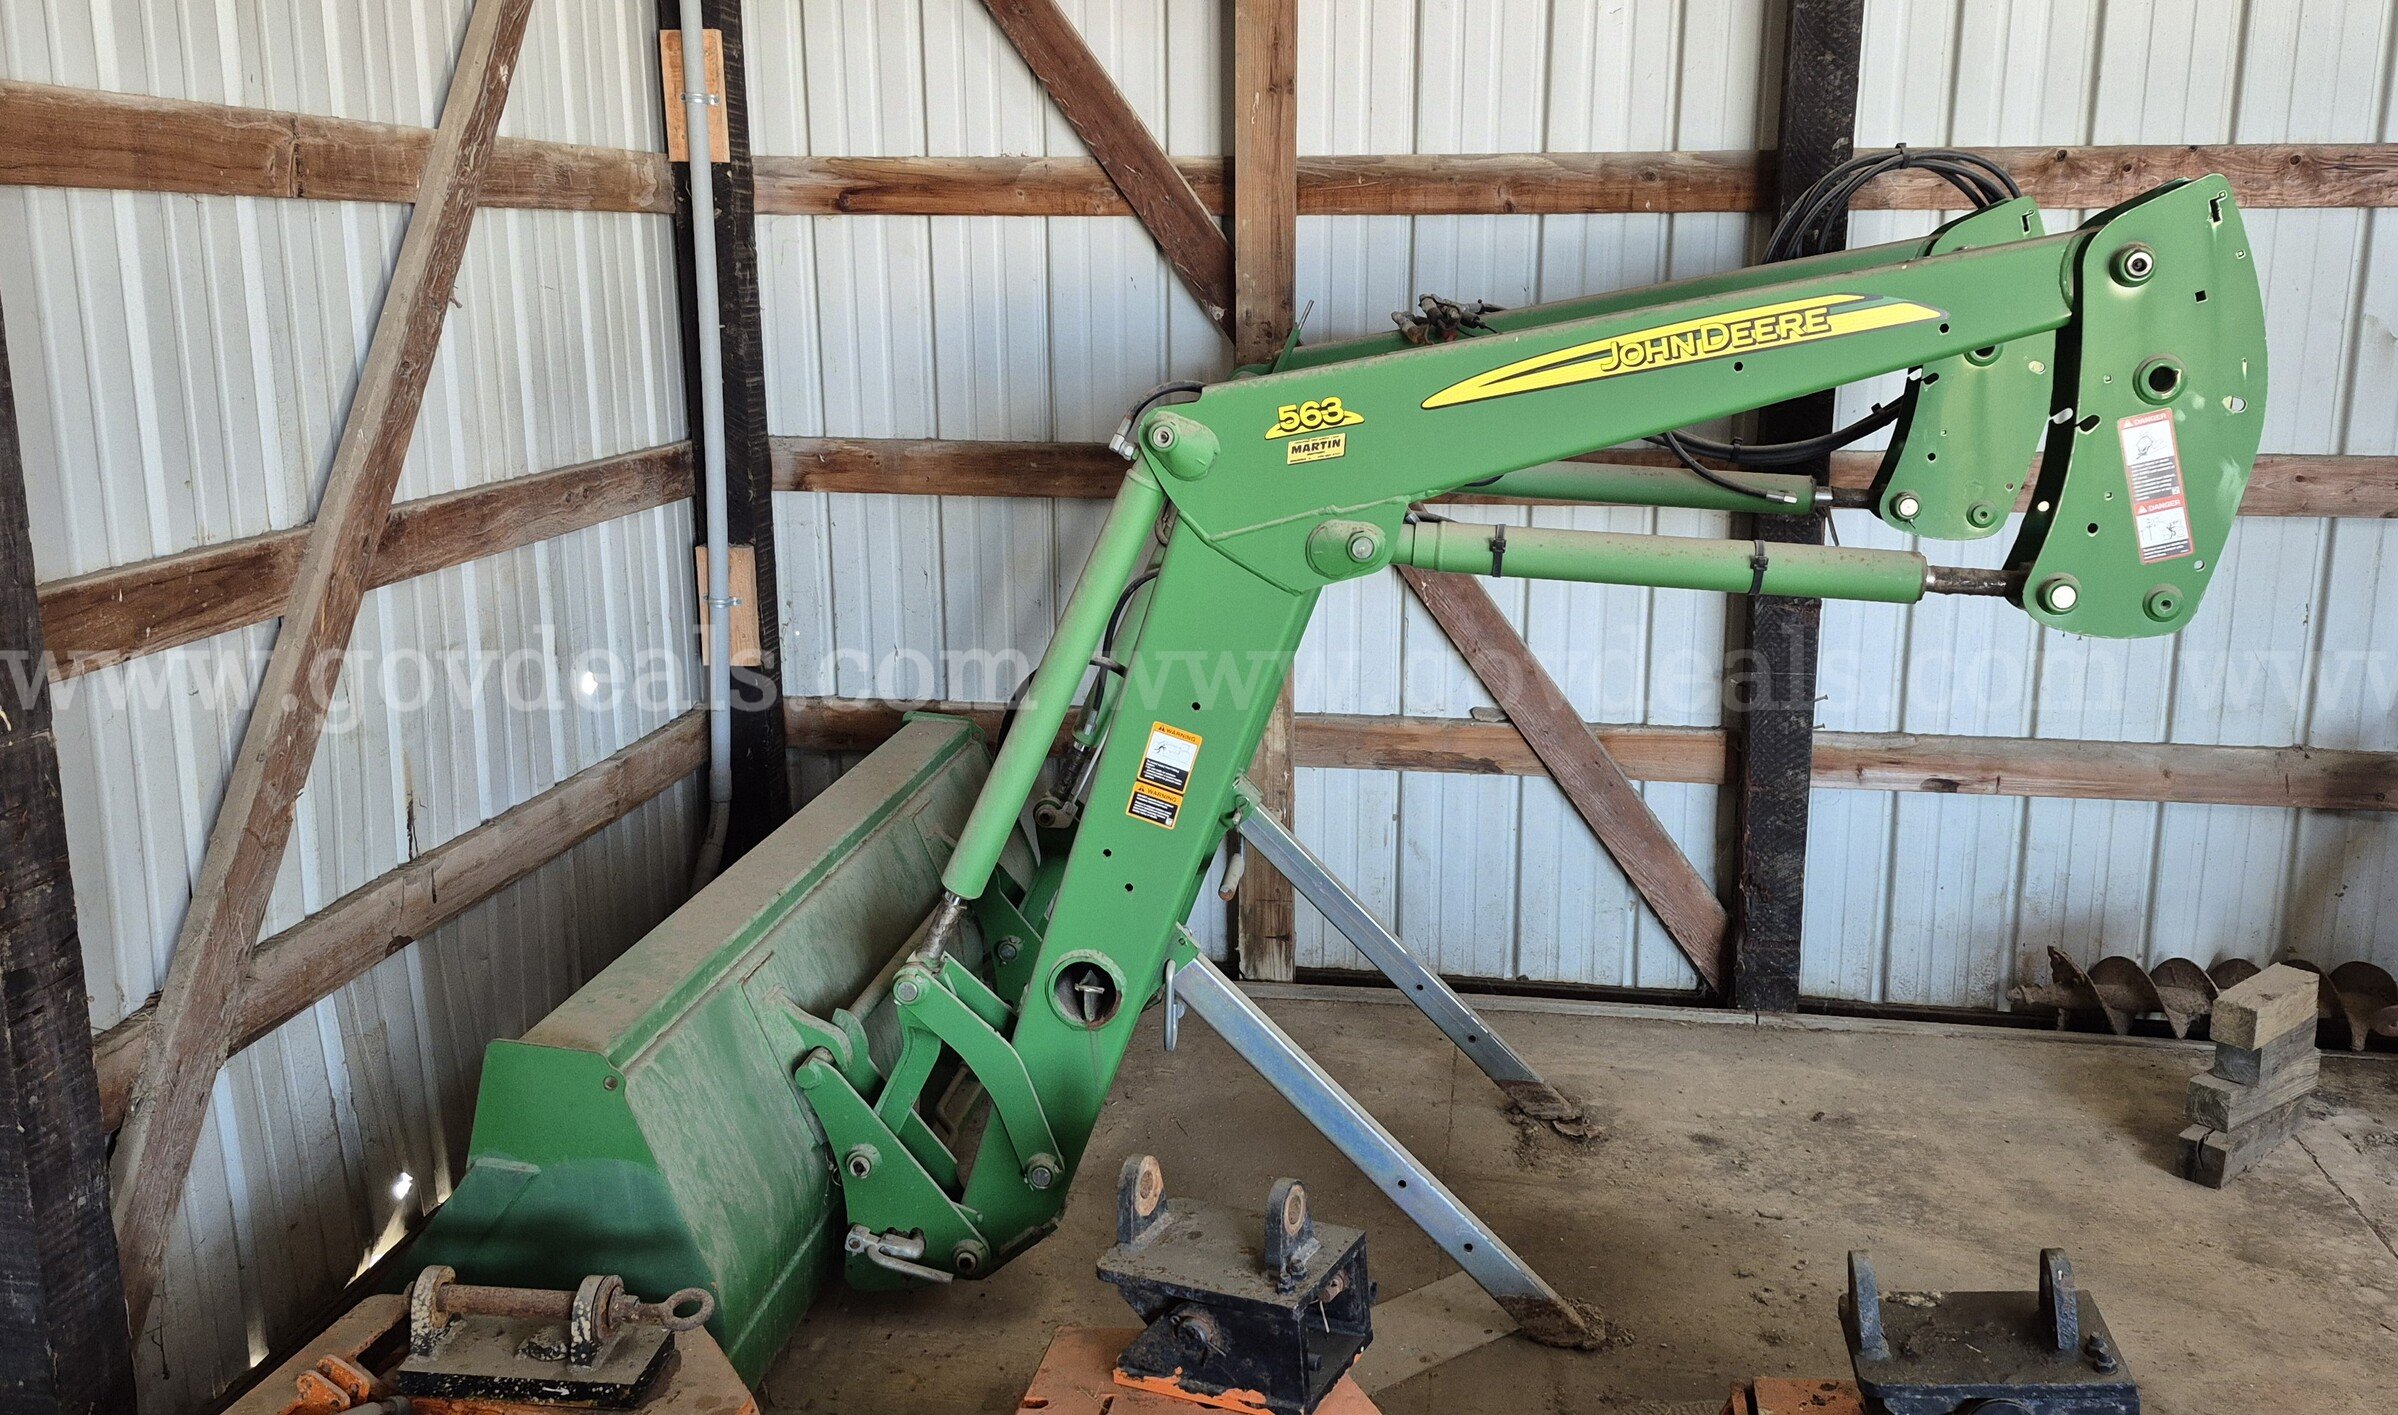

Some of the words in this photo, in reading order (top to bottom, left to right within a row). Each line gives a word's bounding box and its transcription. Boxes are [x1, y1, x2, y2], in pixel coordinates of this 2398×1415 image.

[1600, 332, 1697, 371] JOHN
[1700, 307, 1832, 353] DEERE
[1278, 396, 1345, 432] 563
[2134, 413, 2167, 426] DANGER
[1291, 438, 1341, 454] MARTIN
[2148, 499, 2181, 511] DANGER
[1165, 728, 1196, 743] WARNING
[1147, 788, 1177, 803] WARNING
